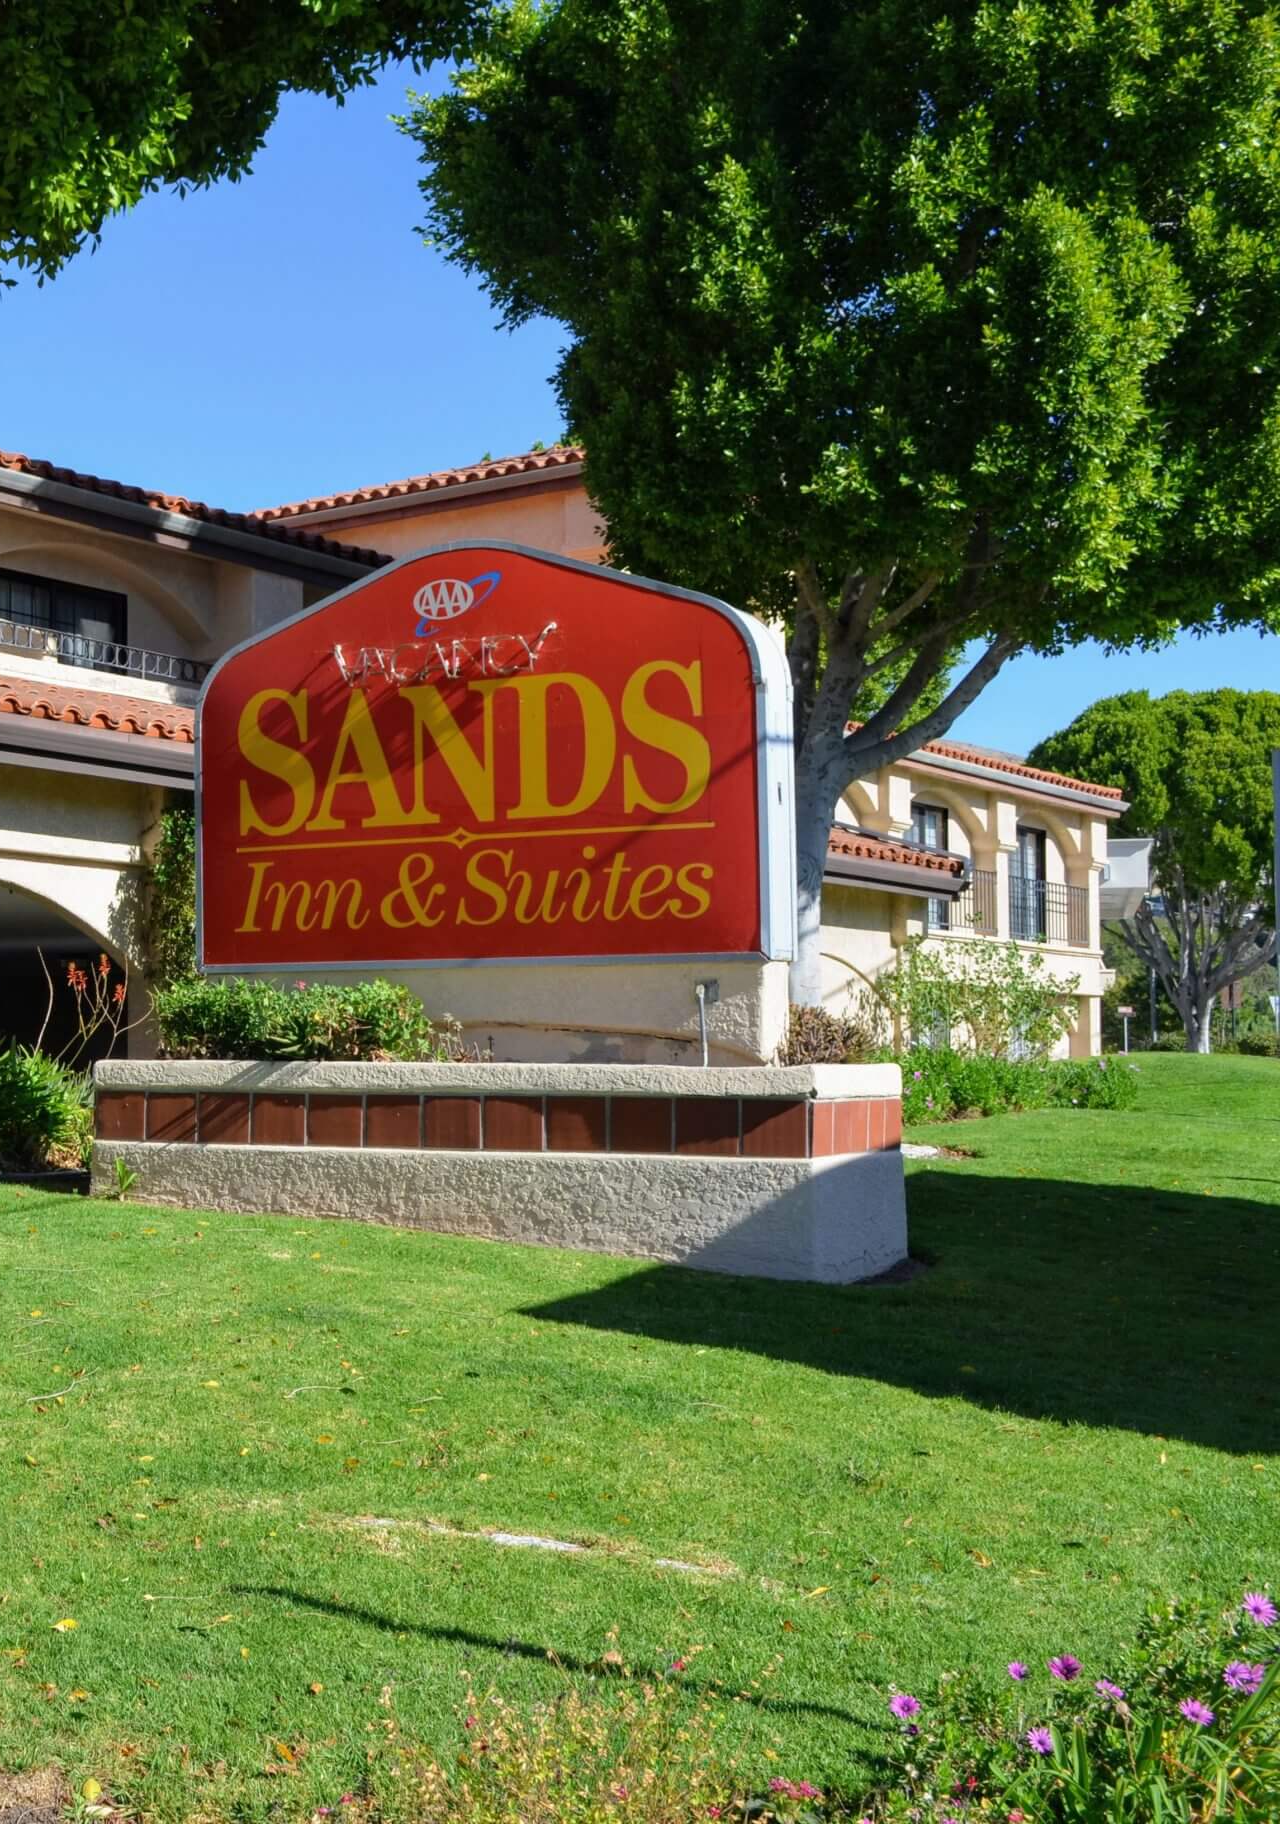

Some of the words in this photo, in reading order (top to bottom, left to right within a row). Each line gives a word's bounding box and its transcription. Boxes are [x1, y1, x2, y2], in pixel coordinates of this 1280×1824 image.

[418, 580, 470, 618] AAA
[332, 621, 558, 688] VACANCY
[237, 659, 713, 838] SANDS
[234, 861, 370, 932] Inn
[380, 852, 447, 929] &
[455, 845, 714, 926] Suites
